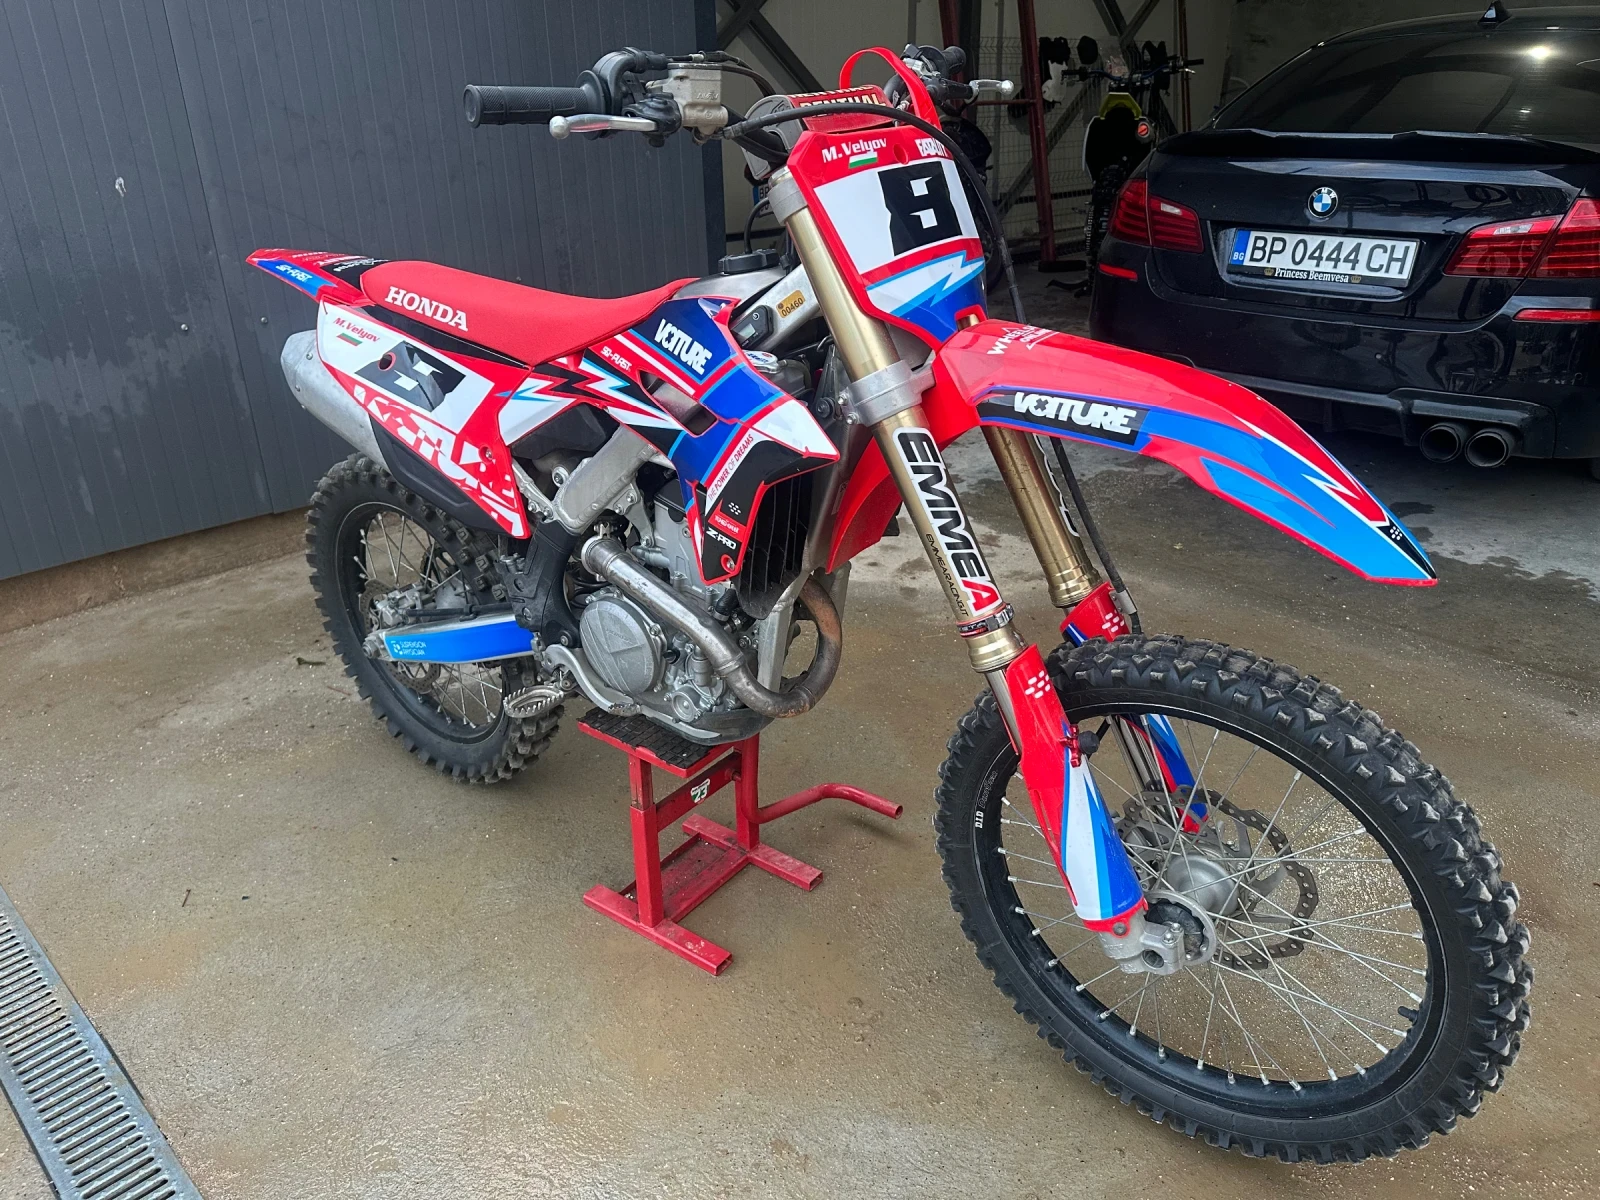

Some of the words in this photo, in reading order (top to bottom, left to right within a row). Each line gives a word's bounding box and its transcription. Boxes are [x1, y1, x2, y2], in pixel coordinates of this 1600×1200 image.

[822, 138, 887, 163] M.Velyov
[877, 160, 963, 257] 8
[1233, 251, 1244, 261] BG
[1248, 236, 1287, 264] BP
[1291, 238, 1361, 271] 0444
[1366, 243, 1411, 275] CH
[1274, 267, 1308, 280] Princess
[1308, 270, 1349, 283] Beemvesa
[385, 286, 468, 332] HONDA
[781, 297, 804, 317] 00460
[333, 317, 380, 342] M.Velyov
[714, 469, 731, 490] POWER
[728, 460, 736, 472] OF
[733, 433, 754, 462] DREAMS
[897, 432, 1000, 612] EMMEA
